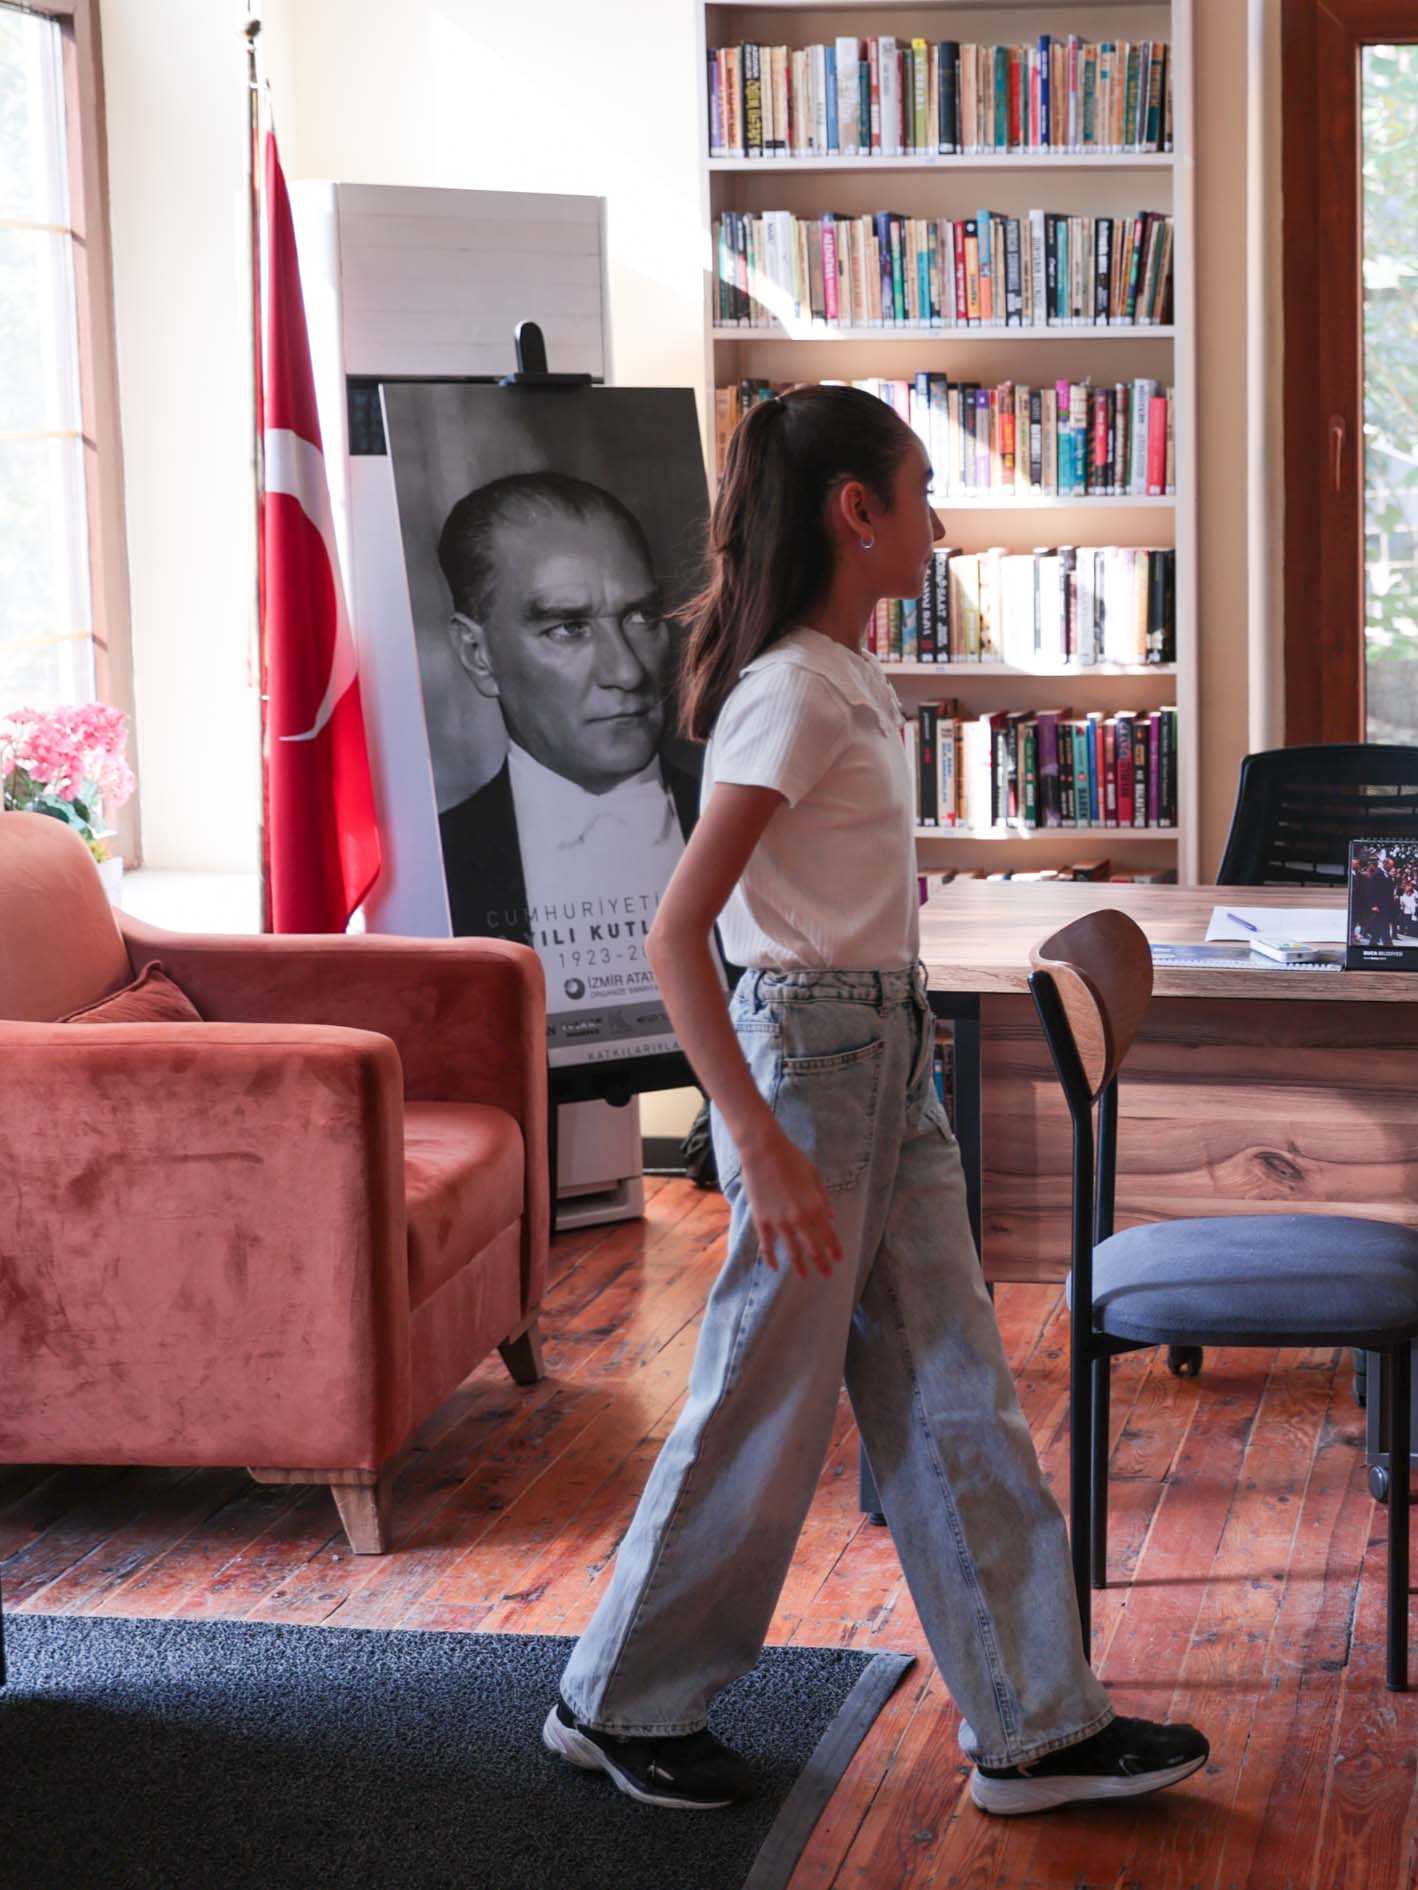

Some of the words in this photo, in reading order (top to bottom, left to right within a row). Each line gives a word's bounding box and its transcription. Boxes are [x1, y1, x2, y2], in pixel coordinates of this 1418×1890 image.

[486, 891, 660, 928] CUMHURİYETİ
[590, 920, 650, 941] KUTL
[587, 974, 624, 989] İZMİR
[627, 970, 656, 985] ATAT
